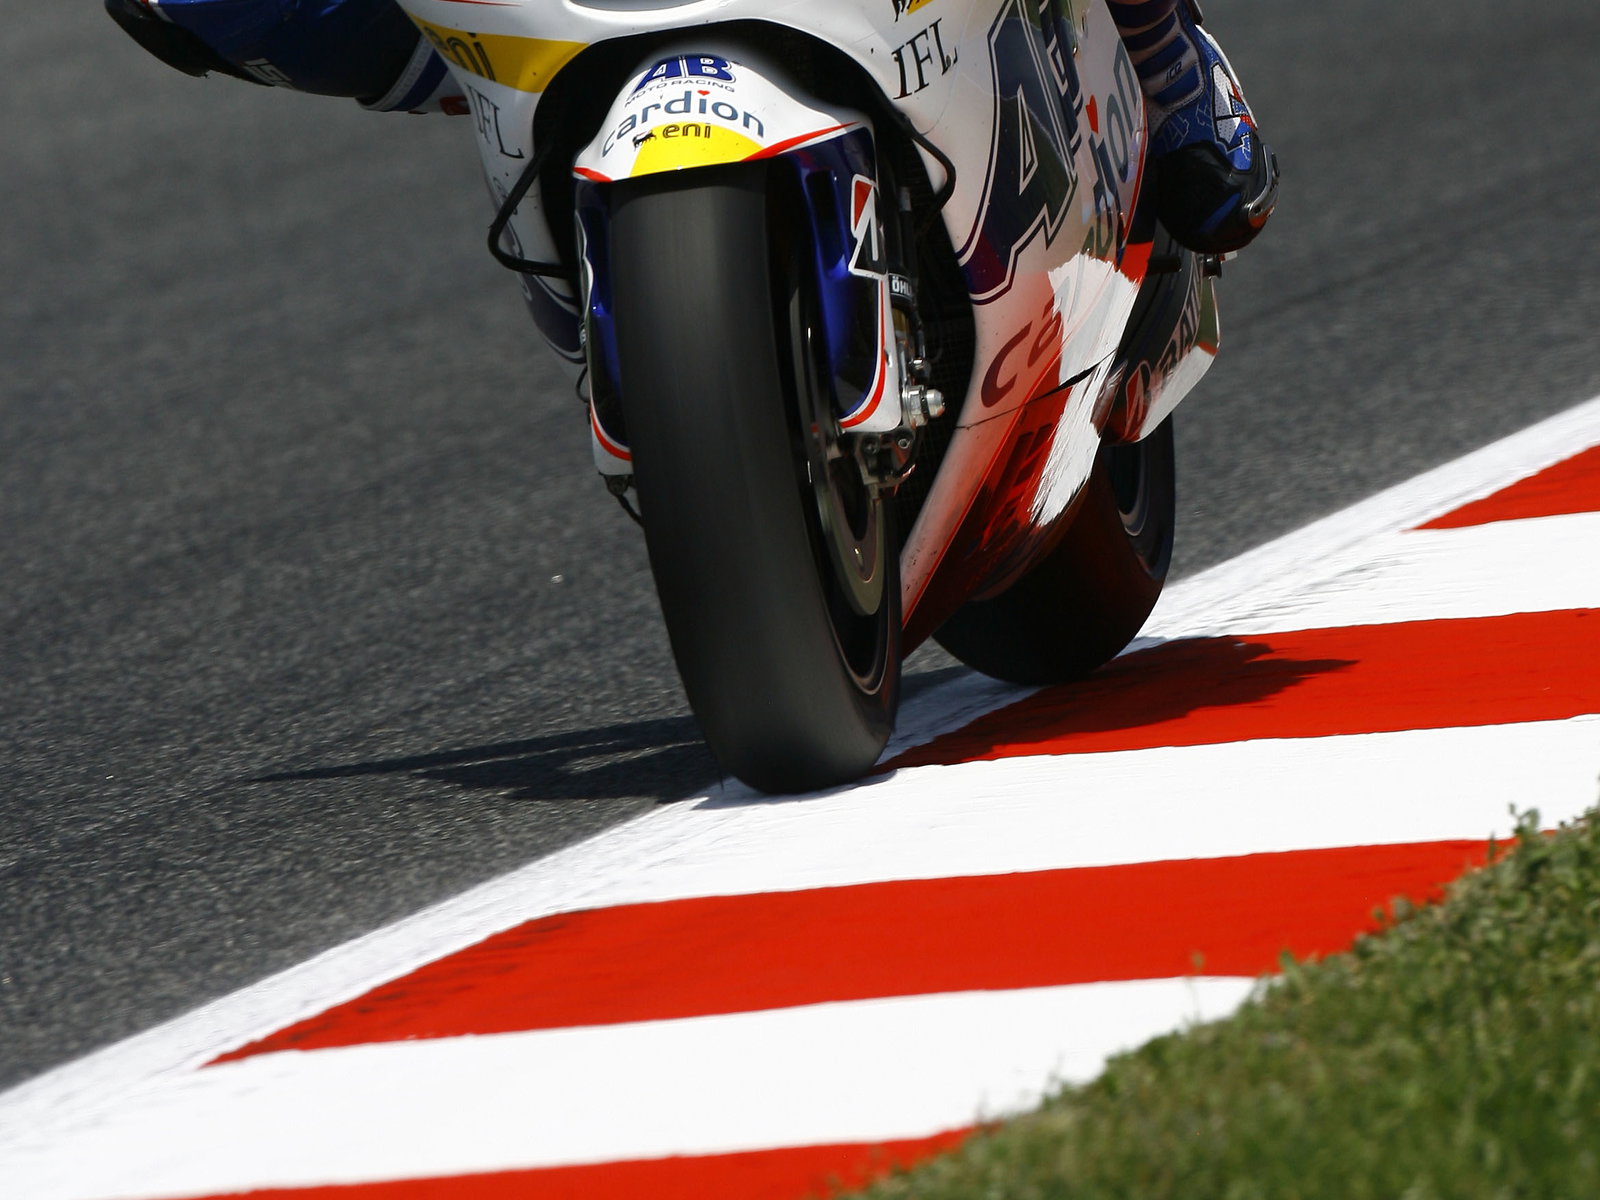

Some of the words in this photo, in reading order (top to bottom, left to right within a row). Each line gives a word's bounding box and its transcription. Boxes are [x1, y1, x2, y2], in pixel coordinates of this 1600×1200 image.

[892, 17, 958, 100] IFL
[464, 81, 525, 159] IFL
[602, 90, 765, 158] cardion
[624, 81, 668, 108] MOTO
[670, 78, 735, 93] RACING
[662, 121, 712, 139] eni
